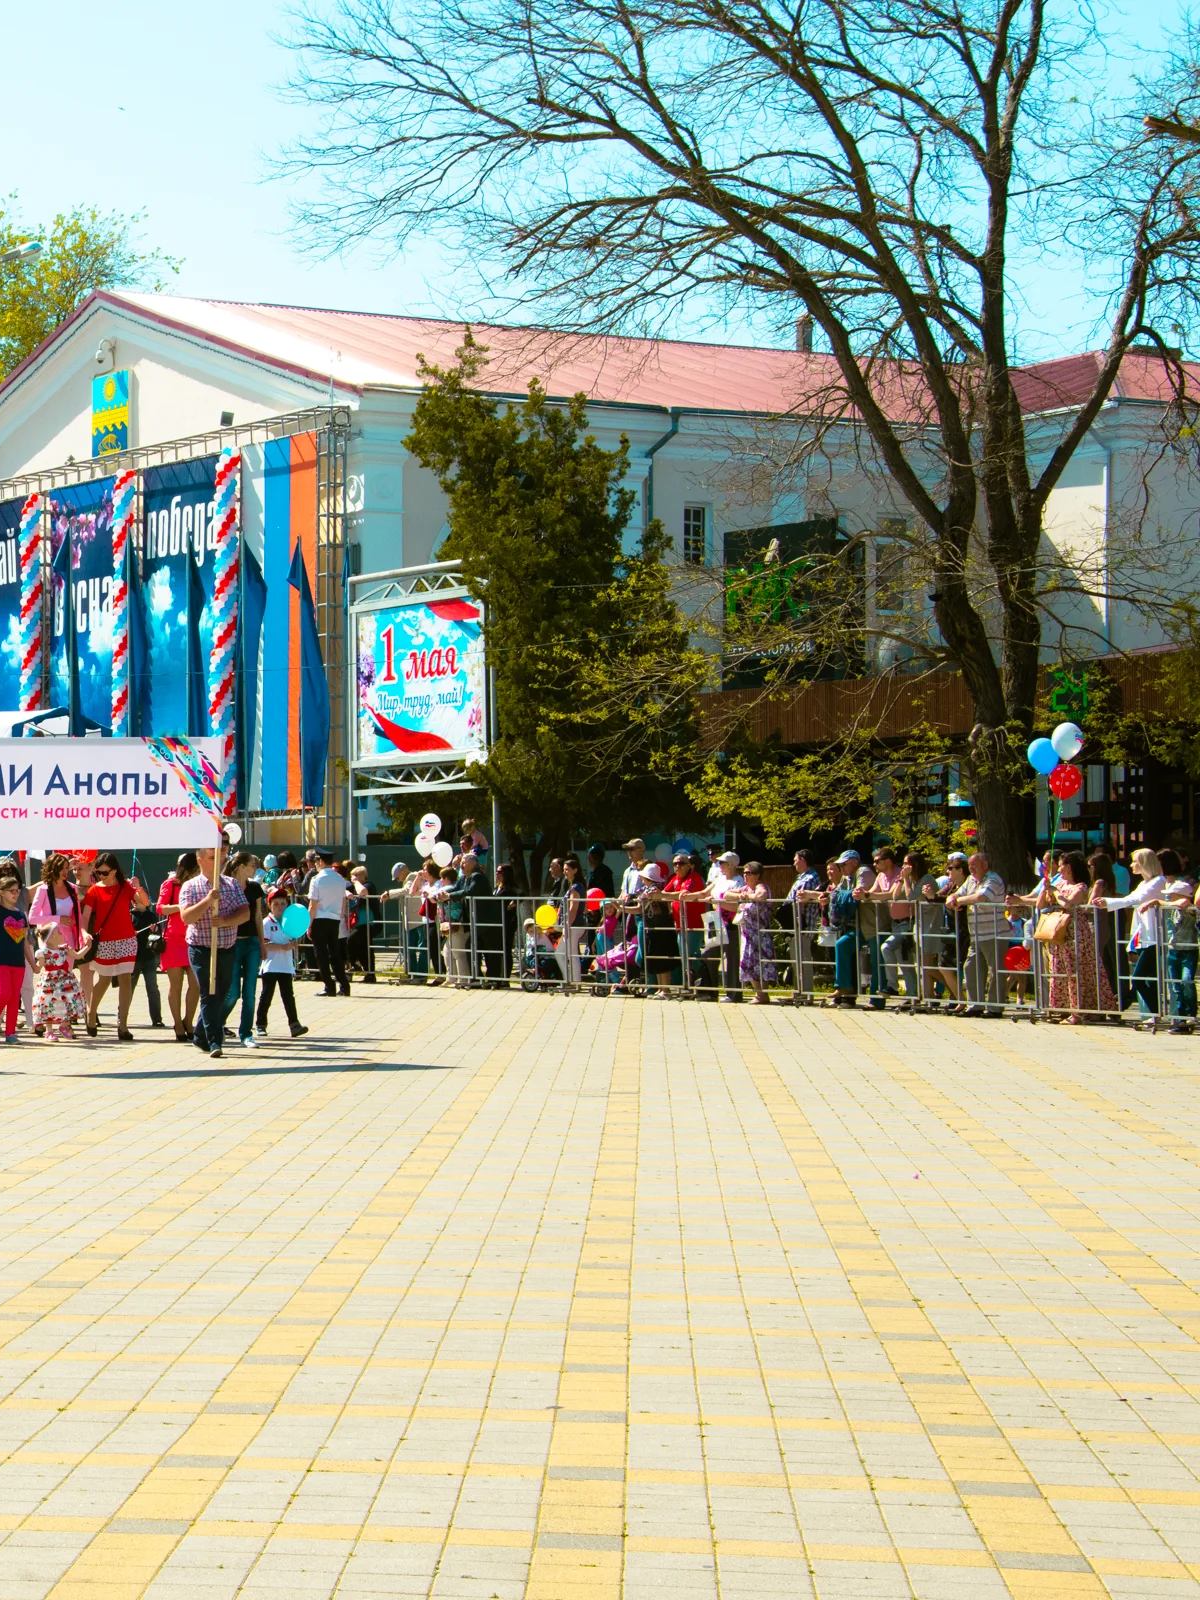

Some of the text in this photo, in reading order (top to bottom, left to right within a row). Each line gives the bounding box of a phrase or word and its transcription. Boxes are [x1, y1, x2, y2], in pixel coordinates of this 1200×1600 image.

[54, 576, 114, 637] всна
[382, 627, 460, 681] 1 мая
[376, 686, 463, 717] Мир, труд, май!
[1052, 672, 1088, 711] 24
[43, 763, 168, 797] Анапы
[44, 806, 91, 819] наша
[95, 801, 193, 824] профессия!
